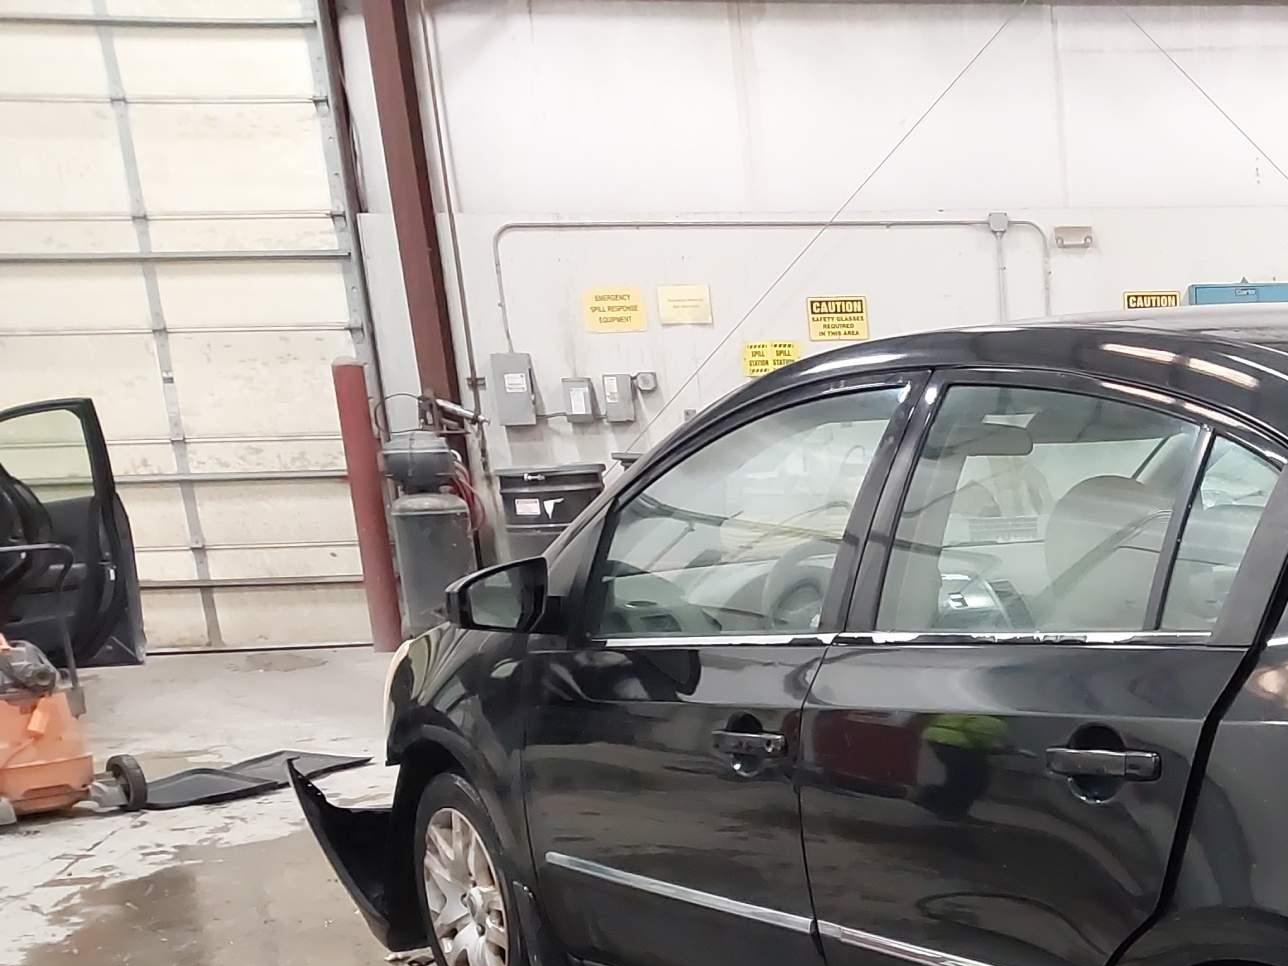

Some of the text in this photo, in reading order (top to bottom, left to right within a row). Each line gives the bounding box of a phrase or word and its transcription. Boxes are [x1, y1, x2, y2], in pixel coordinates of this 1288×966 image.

[812, 301, 862, 313] CAUTION
[1129, 297, 1176, 308] CAUTION
[775, 349, 792, 357] SPILL
